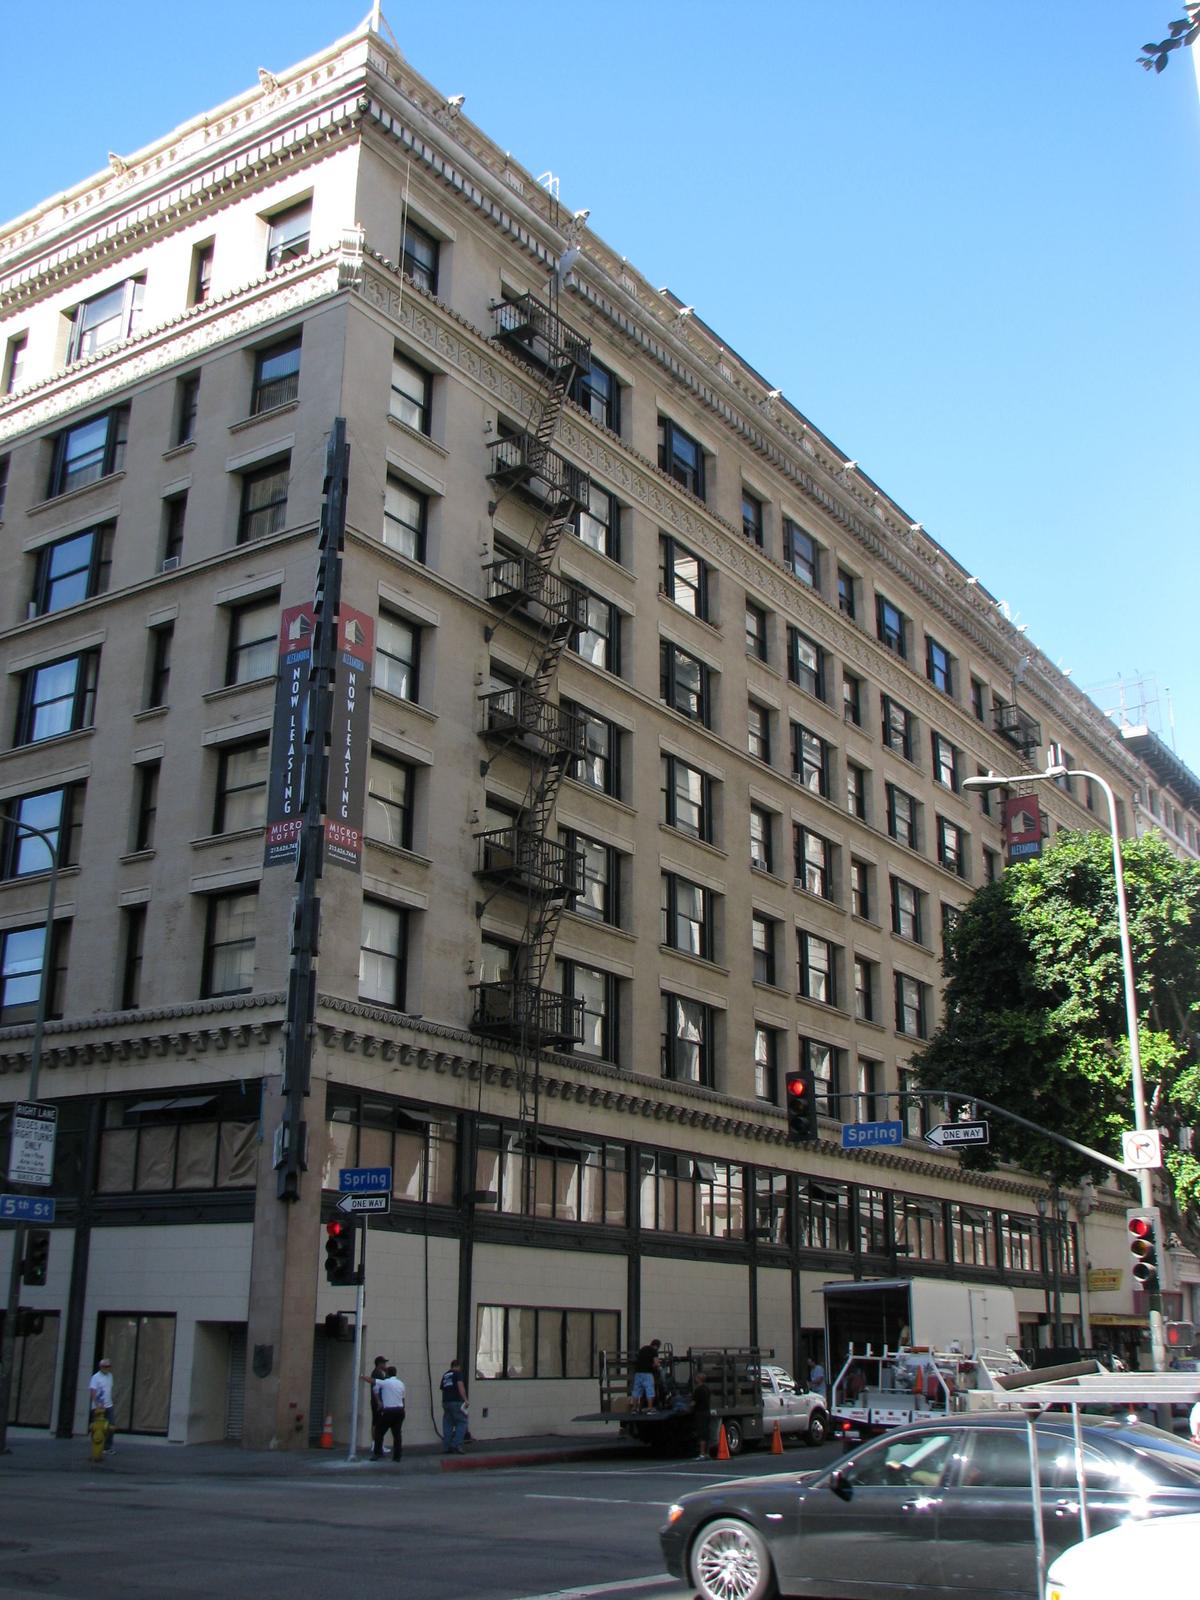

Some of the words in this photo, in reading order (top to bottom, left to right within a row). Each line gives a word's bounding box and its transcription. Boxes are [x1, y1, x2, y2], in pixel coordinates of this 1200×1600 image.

[290, 667, 300, 708] NOW
[348, 671, 357, 713] NOW
[284, 715, 296, 814] LEASING
[341, 719, 352, 819] LEASING
[271, 821, 302, 834] MICRO
[329, 823, 358, 840] MICRO
[271, 831, 298, 842] LOFT
[328, 832, 357, 848] LOFTS
[16, 1104, 37, 1116] RIGHT
[38, 1108, 57, 1120] LANE
[848, 1126, 897, 1142] Spring
[943, 1129, 961, 1139] ONE
[963, 1128, 982, 1138] WAY
[344, 1172, 387, 1187] Spring
[3, 1199, 30, 1215] 5th
[33, 1203, 50, 1216] St
[352, 1200, 367, 1208] ONE
[368, 1199, 384, 1207] WAY
